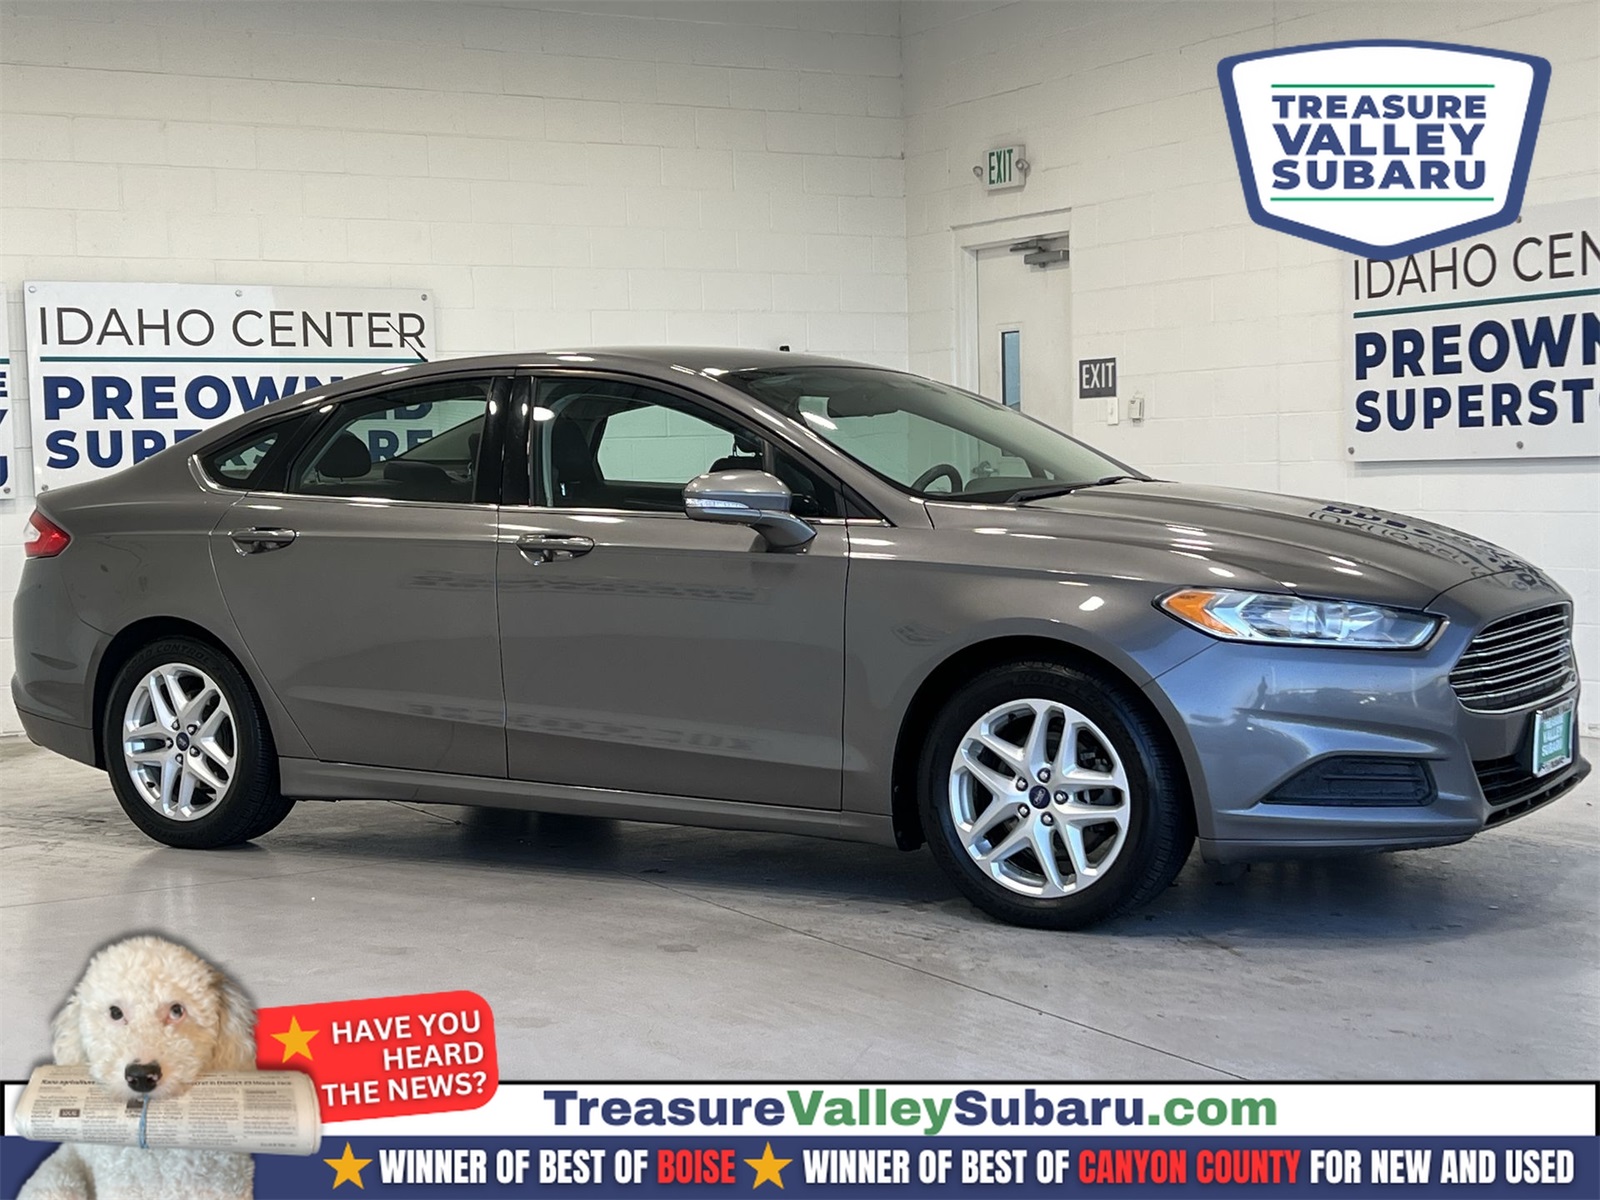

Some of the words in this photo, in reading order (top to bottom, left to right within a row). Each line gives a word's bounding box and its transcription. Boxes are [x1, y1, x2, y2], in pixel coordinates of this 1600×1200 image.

[988, 149, 1013, 185] EXIT
[1354, 243, 1497, 300] IDAHO
[40, 307, 214, 346] IDAHO
[232, 310, 426, 349] CENTER
[1082, 361, 1115, 389] EXIT
[1355, 378, 1600, 432] SUPERST
